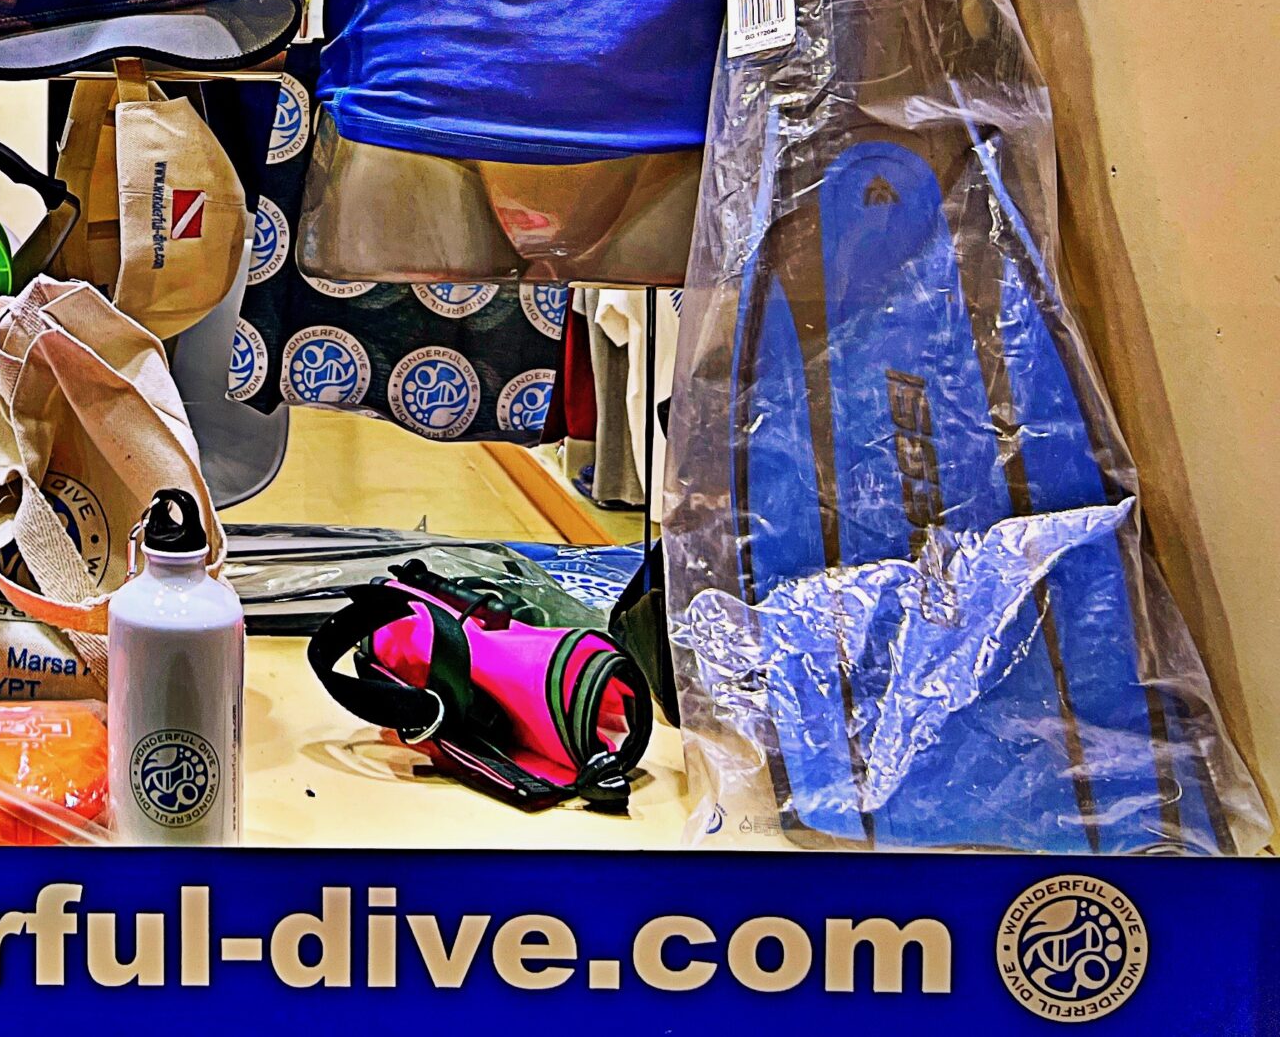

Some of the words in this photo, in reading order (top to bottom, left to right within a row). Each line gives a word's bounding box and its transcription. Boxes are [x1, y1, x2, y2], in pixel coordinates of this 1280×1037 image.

[297, 90, 309, 116] DIVE
[269, 134, 305, 160] WONDE
[272, 211, 286, 236] DIVE
[523, 293, 539, 320] DIVE
[249, 332, 264, 359] DIVE
[285, 329, 348, 359] WONDERFUL
[351, 344, 367, 371] DIVE
[395, 349, 463, 378] WONDERFUL
[463, 365, 478, 392] DIVE
[503, 373, 552, 399] WONDER
[392, 394, 408, 421] DIVE
[50, 479, 97, 521] DIVE
[8, 647, 77, 675] Marsa
[134, 733, 196, 766] WONDERFUL
[198, 743, 217, 768] DIVE
[133, 782, 151, 811] DIVE
[153, 783, 216, 824] WONDERFUL
[1004, 879, 1107, 935] WONDERFUL
[1111, 896, 1142, 936] DIVE
[1003, 962, 1033, 1001] DIVE
[1038, 963, 1142, 1017] WONDERFUL
